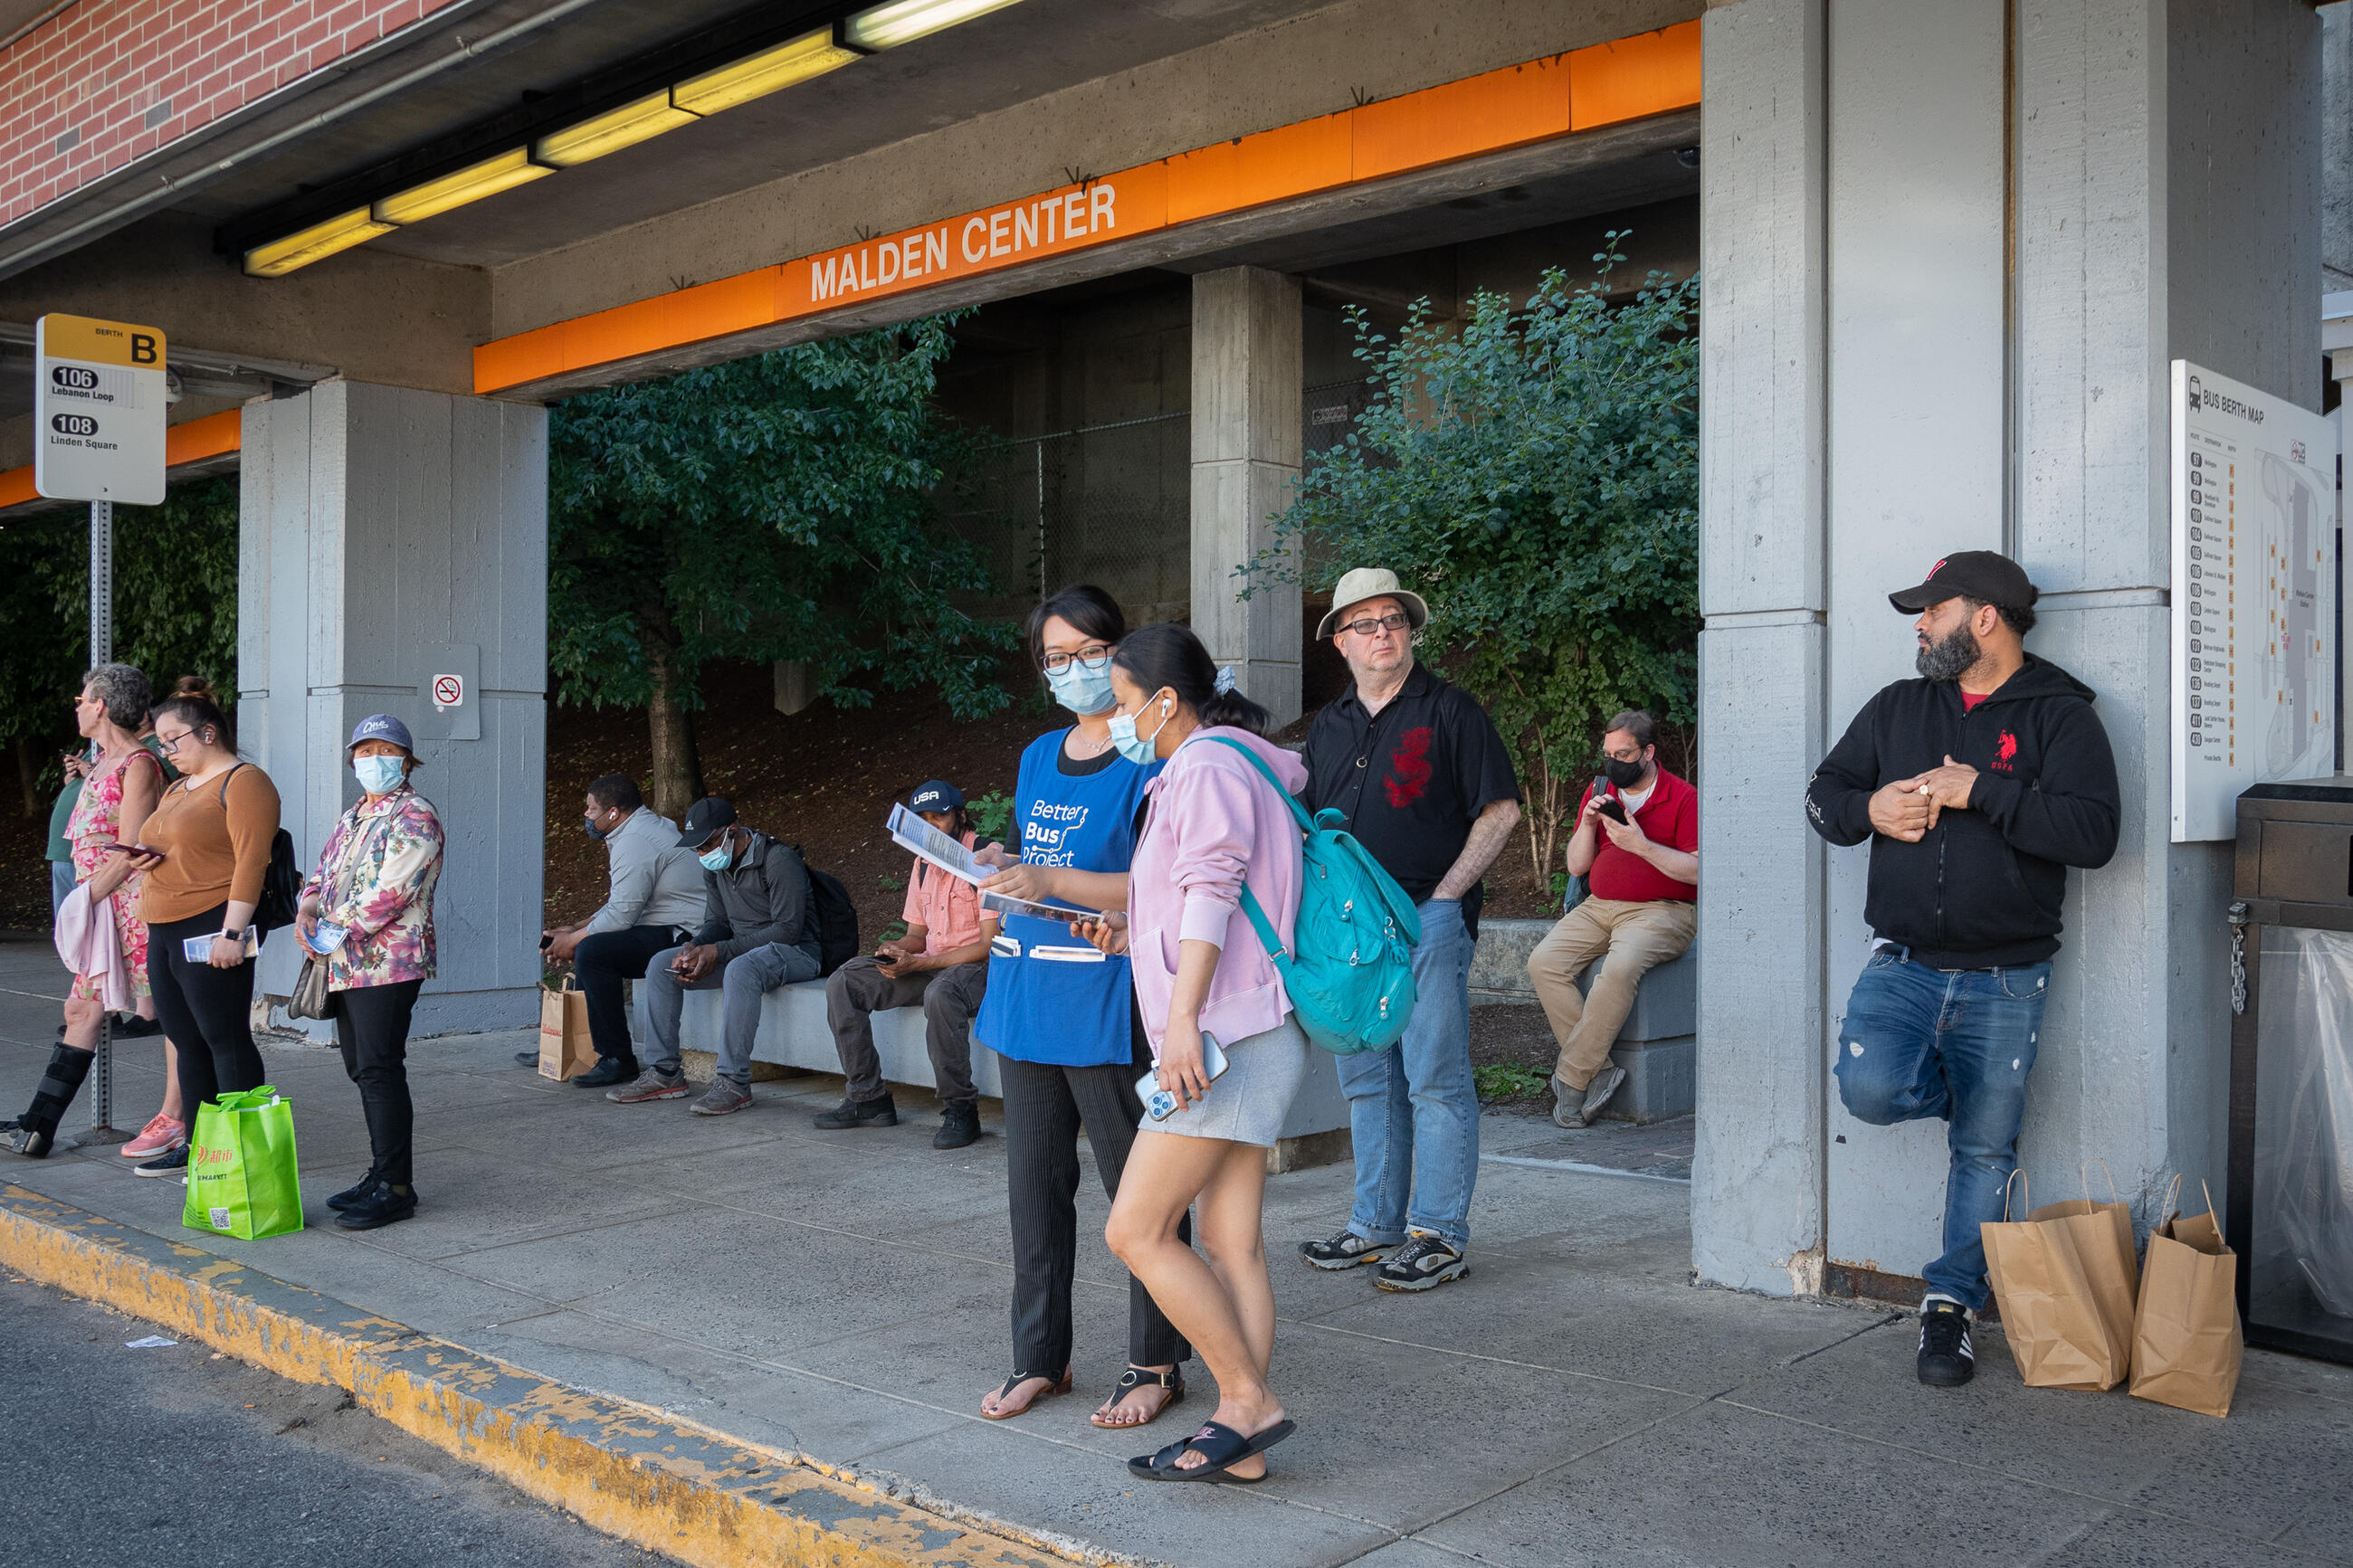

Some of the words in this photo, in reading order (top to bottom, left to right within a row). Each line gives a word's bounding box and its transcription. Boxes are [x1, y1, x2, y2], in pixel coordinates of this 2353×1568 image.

[812, 227, 948, 302] MALDEN
[961, 184, 1117, 264] CENTER
[95, 327, 124, 338] BERTH
[131, 333, 157, 364] B
[58, 367, 93, 388] 106
[52, 385, 90, 399] Lebanon
[92, 390, 114, 403] Loop
[2203, 389, 2220, 409] BUS
[2221, 396, 2246, 420] BERTH
[2247, 405, 2264, 425] MAP
[58, 415, 92, 434] 108
[51, 435, 82, 447] Linden
[85, 439, 118, 451] Square
[913, 791, 939, 805] USA
[1031, 799, 1083, 821] Better
[1024, 822, 1060, 844] Bus
